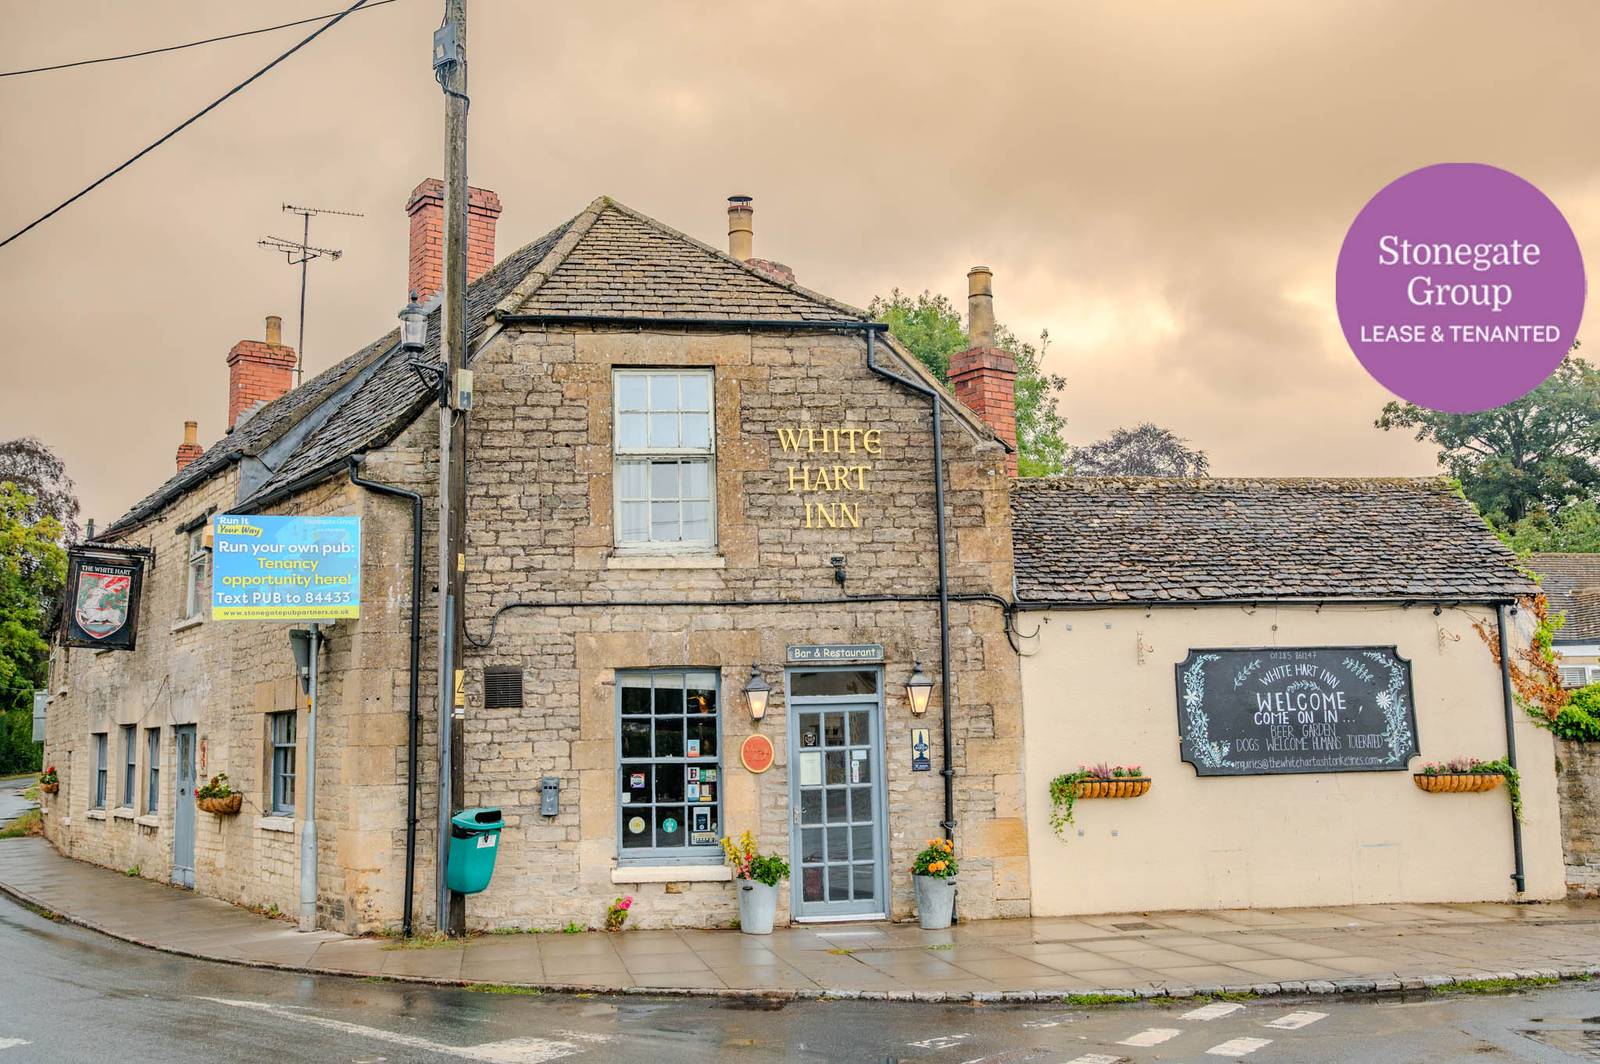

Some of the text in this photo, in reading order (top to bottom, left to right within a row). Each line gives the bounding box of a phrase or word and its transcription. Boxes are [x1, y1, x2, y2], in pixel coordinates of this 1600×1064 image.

[777, 428, 882, 454] WHITE
[787, 465, 872, 491] HART
[219, 516, 249, 525] Run It
[804, 502, 860, 528] INN
[220, 525, 261, 536] Your Way
[218, 541, 355, 556] Run your own pub:
[94, 566, 113, 574] WHITE
[114, 568, 131, 576] HART
[257, 557, 320, 571] Tenancy
[222, 574, 352, 588] opportunity here!
[216, 592, 351, 604] Text PUB to 84433
[223, 609, 349, 617] www.stonegatepubpartners.co.uk
[794, 648, 877, 658] Bar & Restaurant
[1259, 663, 1341, 689] WHITE HART INN
[1256, 691, 1347, 713] WELCOME
[1253, 711, 1290, 725] COME
[1297, 711, 1314, 724] ON
[1270, 723, 1337, 738] BEER GARDEN
[1235, 734, 1384, 752] DOGS WELCOME HUMANS TOLERATED
